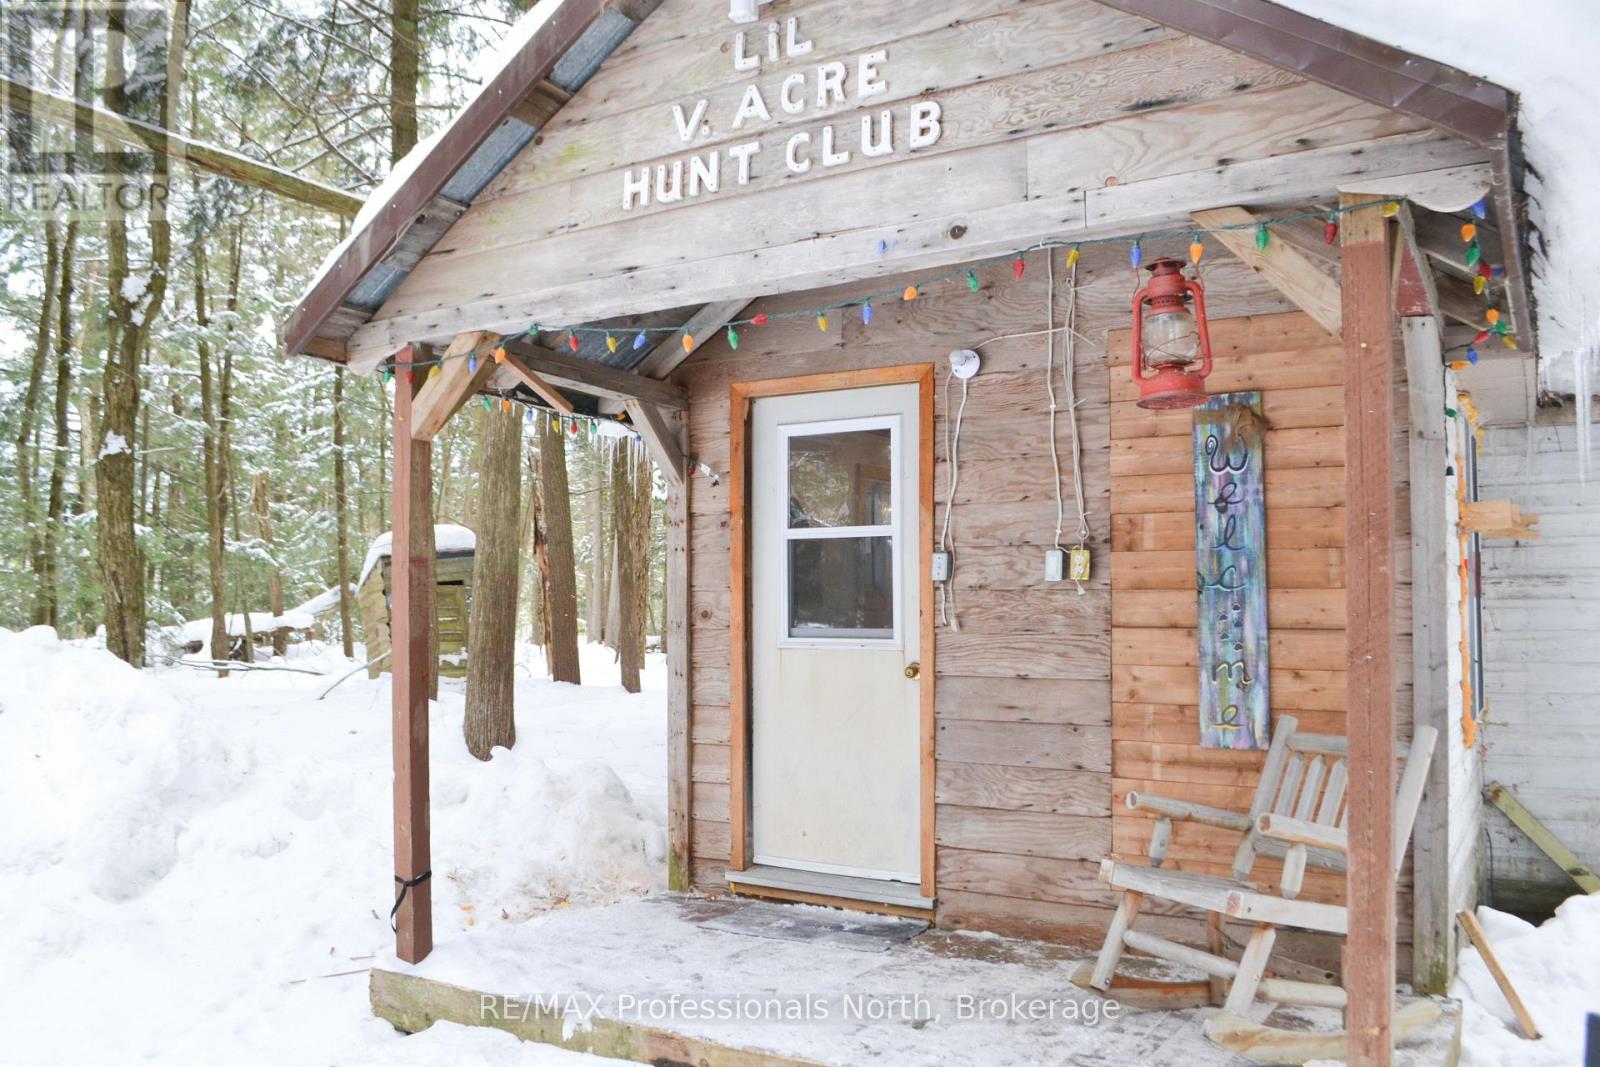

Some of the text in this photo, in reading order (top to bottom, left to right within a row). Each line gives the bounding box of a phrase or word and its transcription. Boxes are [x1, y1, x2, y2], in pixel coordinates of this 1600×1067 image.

[672, 49, 889, 142] V. ACRE
[622, 100, 944, 210] HUNT CLUB
